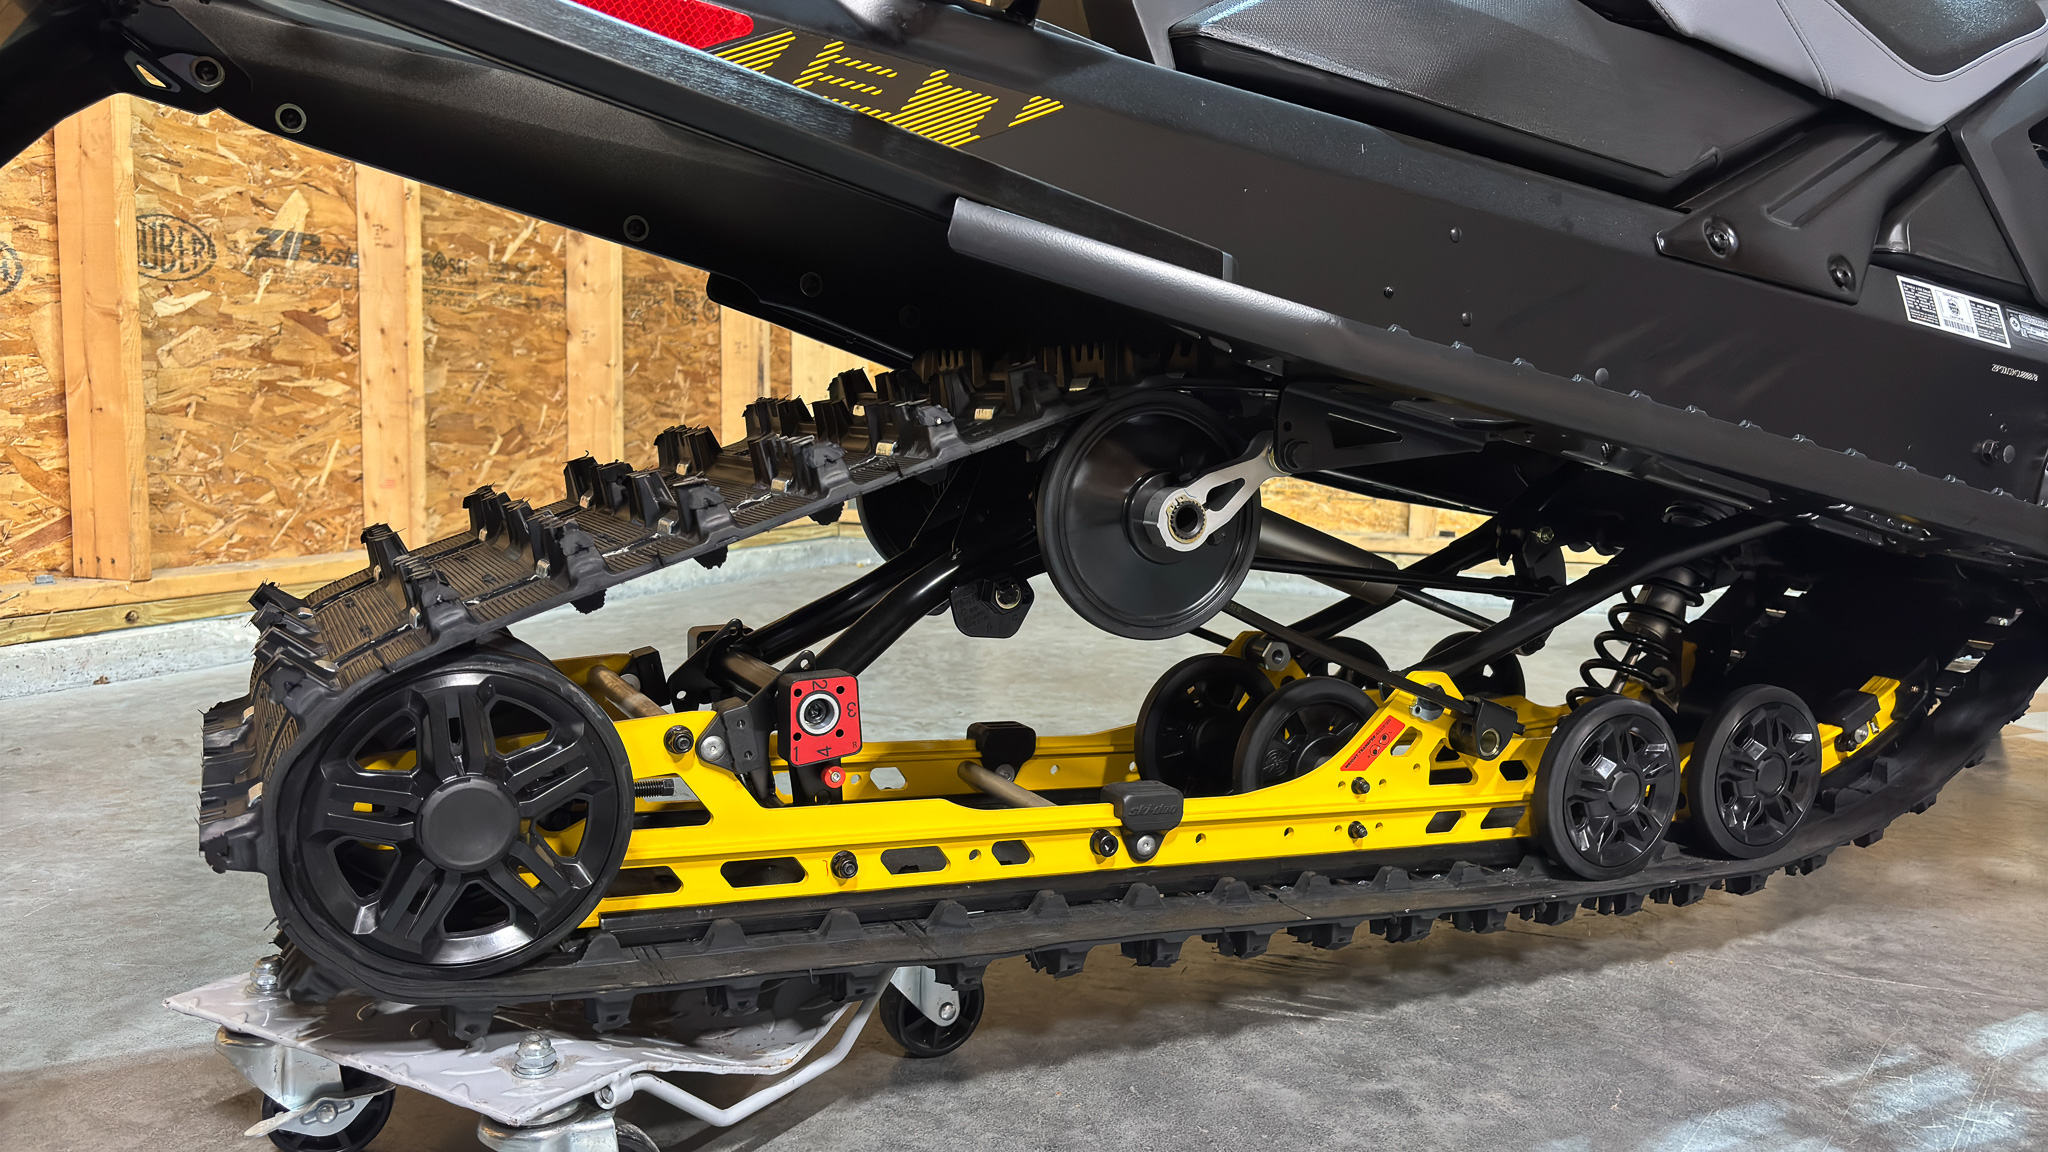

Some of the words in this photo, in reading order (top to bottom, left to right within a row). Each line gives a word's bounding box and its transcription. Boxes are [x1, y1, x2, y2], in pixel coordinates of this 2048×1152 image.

[137, 221, 206, 273] UBER
[250, 227, 321, 261] ZIP
[812, 680, 828, 690] 2
[846, 702, 857, 717] 3
[794, 746, 799, 761] 1
[817, 746, 832, 757] 4
